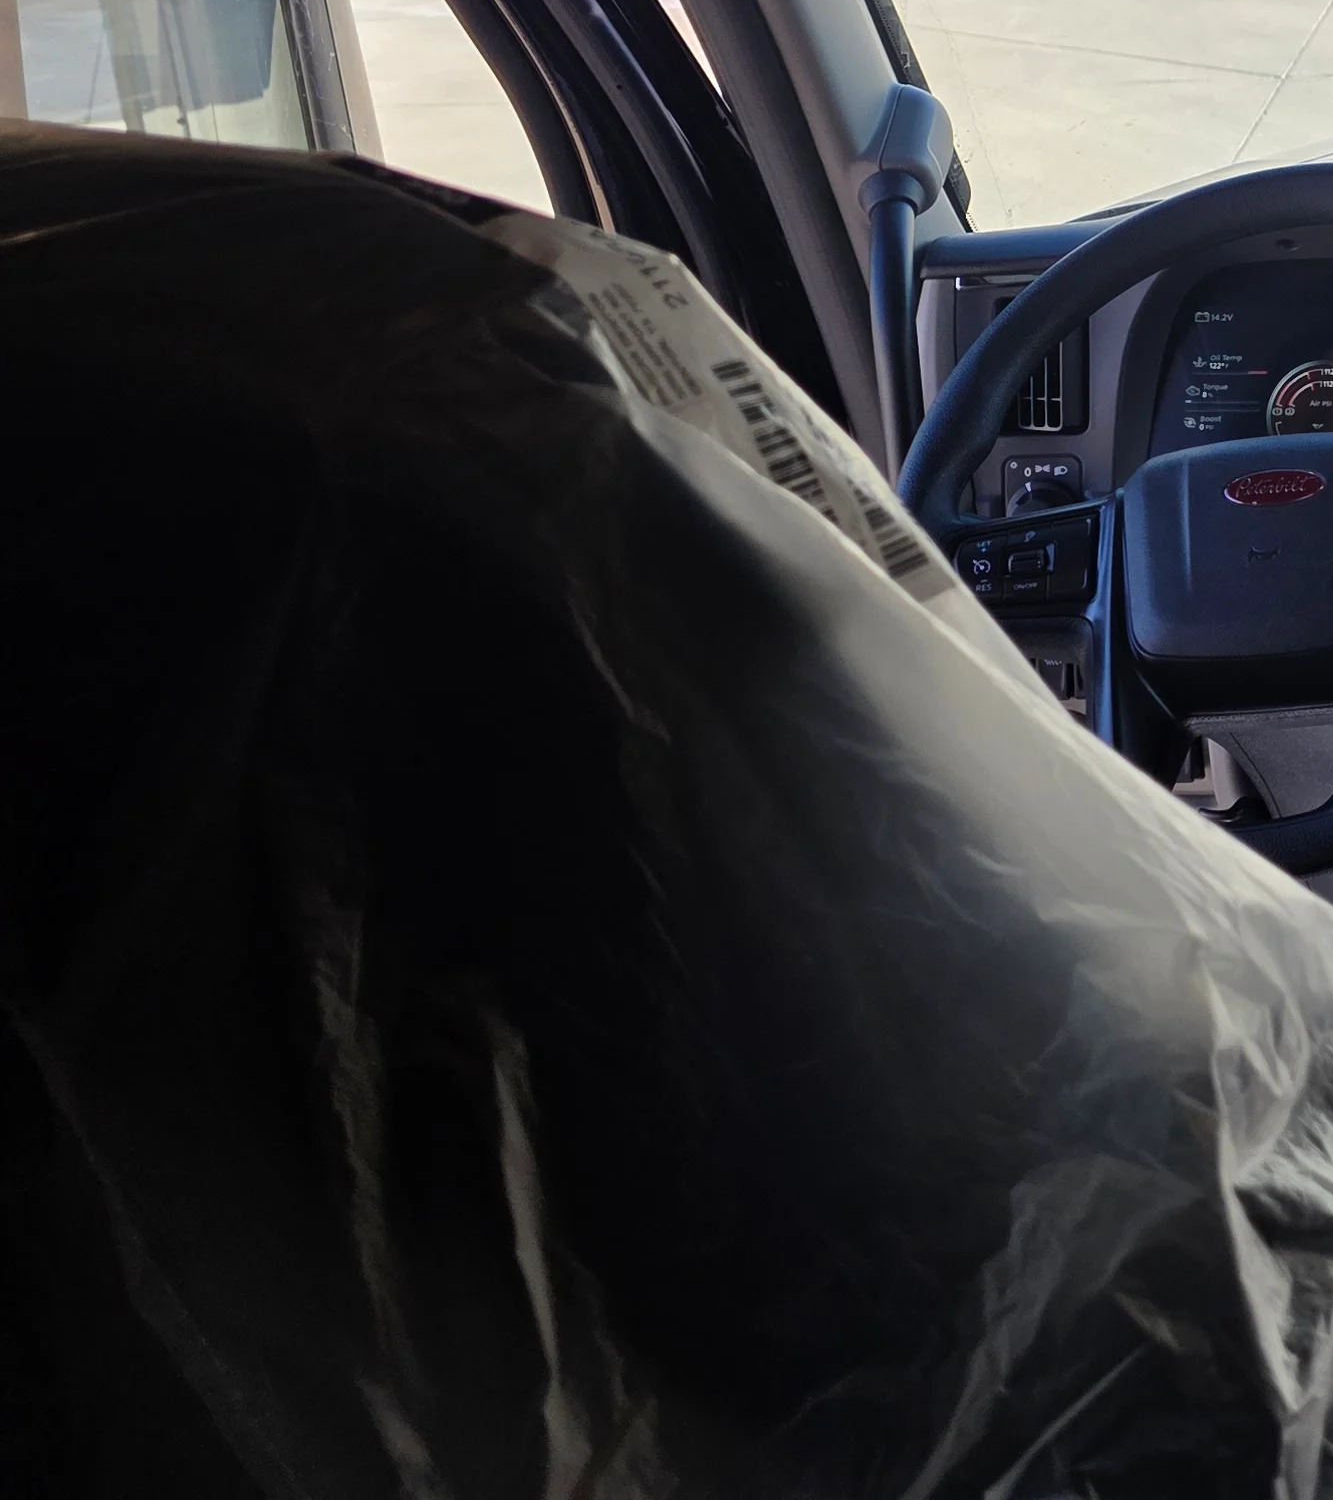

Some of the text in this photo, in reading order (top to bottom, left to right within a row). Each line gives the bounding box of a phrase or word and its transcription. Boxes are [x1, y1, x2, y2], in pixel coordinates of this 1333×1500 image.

[1211, 313, 1234, 322] 14.2V
[1210, 354, 1243, 363] Oil Temp
[1202, 383, 1229, 393] Torque
[1322, 380, 1333, 388] 112
[1309, 399, 1321, 407] Air
[1200, 414, 1222, 423] Boost
[1235, 470, 1309, 498] Peterbilt
[976, 583, 992, 592] RES
[1013, 581, 1038, 591] ON/OFF
